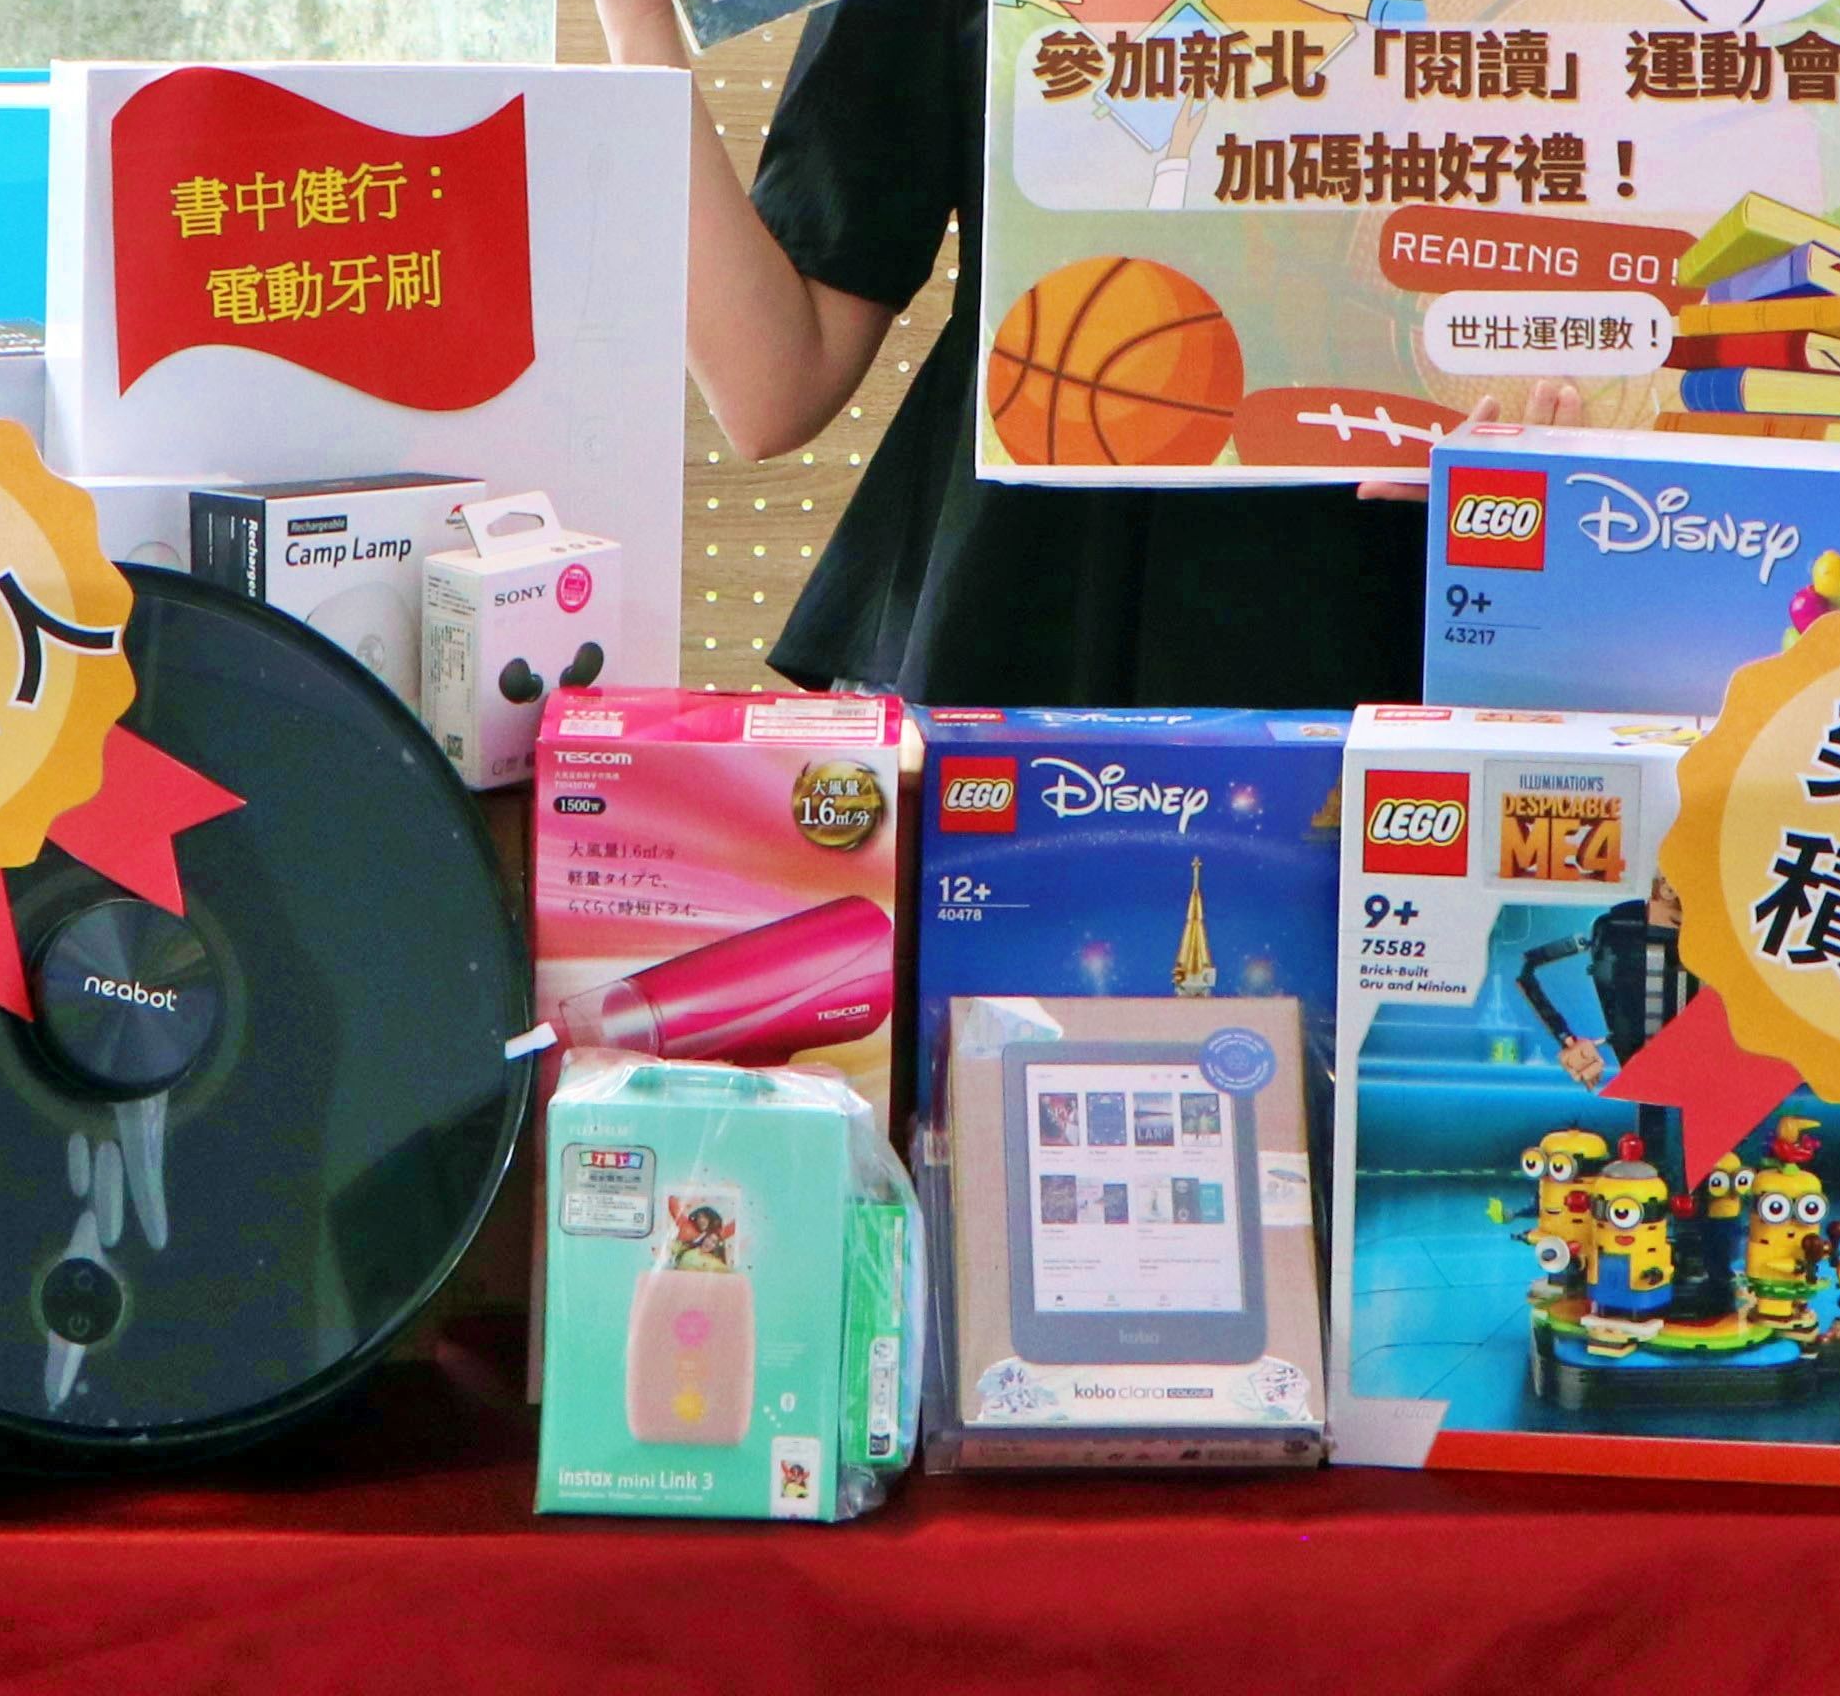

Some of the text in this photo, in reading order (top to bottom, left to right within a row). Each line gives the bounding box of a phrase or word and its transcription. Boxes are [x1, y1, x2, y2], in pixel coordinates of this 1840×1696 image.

[1214, 133, 1638, 204] 加碼抽好禮！
[171, 159, 446, 239] 書中健行：
[1391, 230, 1681, 288] READING GO!
[206, 248, 443, 328] 電動牙刷
[1446, 314, 1662, 353] 世壯運倒數！
[1451, 495, 1543, 540] LEGO
[285, 536, 412, 569] Camp Lamp
[494, 584, 547, 607] SONY
[1446, 585, 1493, 616] 9+
[1445, 629, 1496, 647] 43217
[554, 751, 632, 766] TESCOM
[812, 779, 860, 797] 大風量
[945, 780, 1014, 812] LEGO
[1519, 773, 1605, 792] ILLUMINATION'S
[1502, 792, 1622, 819] DESPICABLE
[1369, 800, 1464, 845] LEGO
[939, 875, 992, 904] 12+
[937, 908, 983, 923] 40478
[1363, 893, 1420, 929] 9+
[1361, 939, 1426, 959] 75582
[1359, 964, 1429, 978] Brick-Built
[83, 975, 173, 1012] neabot
[1359, 978, 1467, 994] Gru and Minions
[816, 1003, 870, 1021] TESCOM
[1074, 1383, 1116, 1400] kobo
[1118, 1383, 1165, 1400] clara
[558, 1468, 714, 1490] instax mini Link 3
